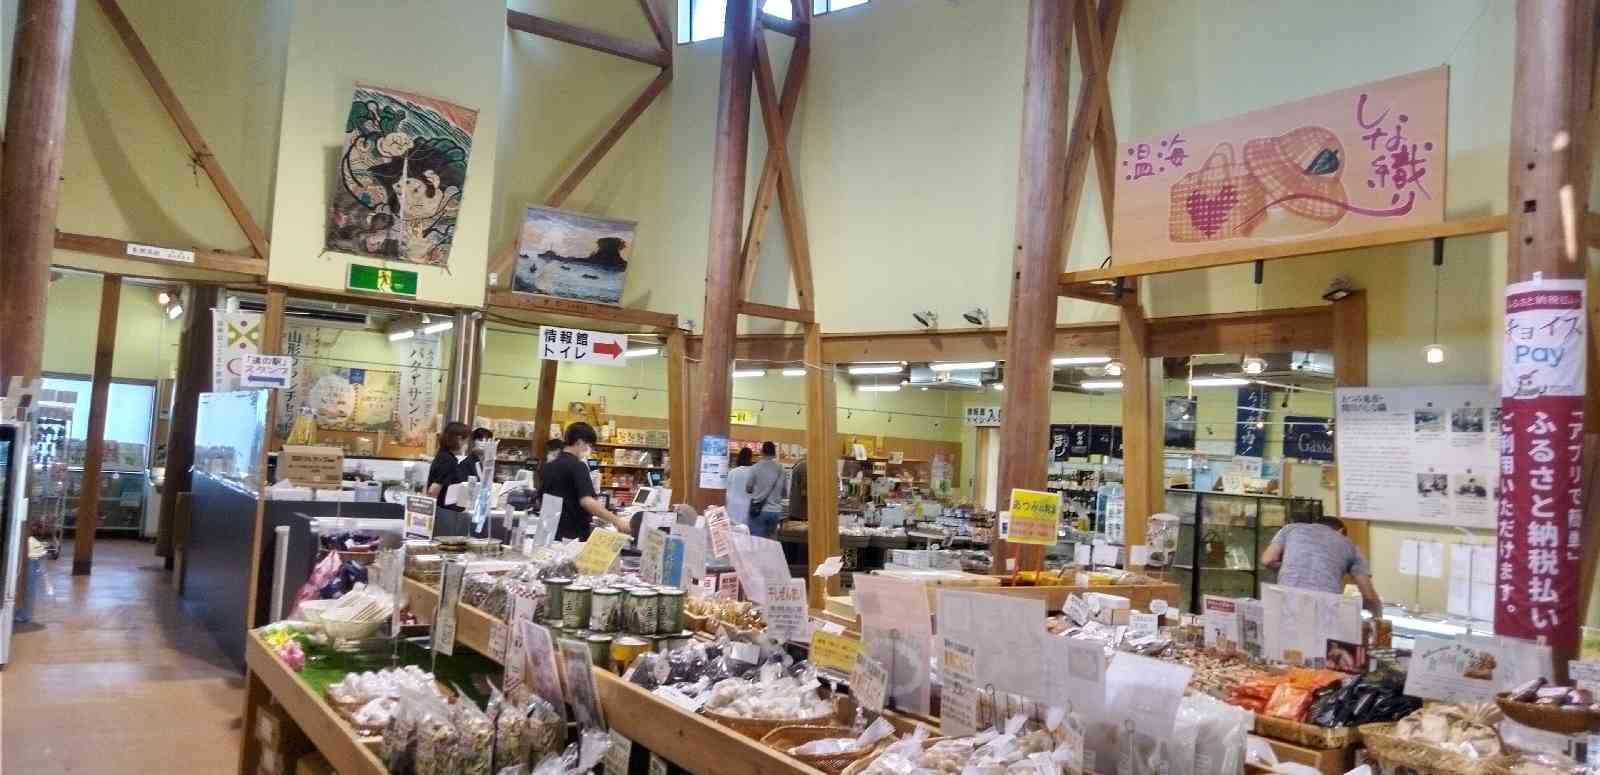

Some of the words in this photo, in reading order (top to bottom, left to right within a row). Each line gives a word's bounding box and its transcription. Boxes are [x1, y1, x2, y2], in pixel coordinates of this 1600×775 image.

[1122, 133, 1190, 181] 温海
[544, 329, 589, 346] 情報館
[544, 344, 587, 359] トイレ
[1515, 345, 1566, 368] Pay
[1526, 411, 1561, 629] ふるさと納税払い
